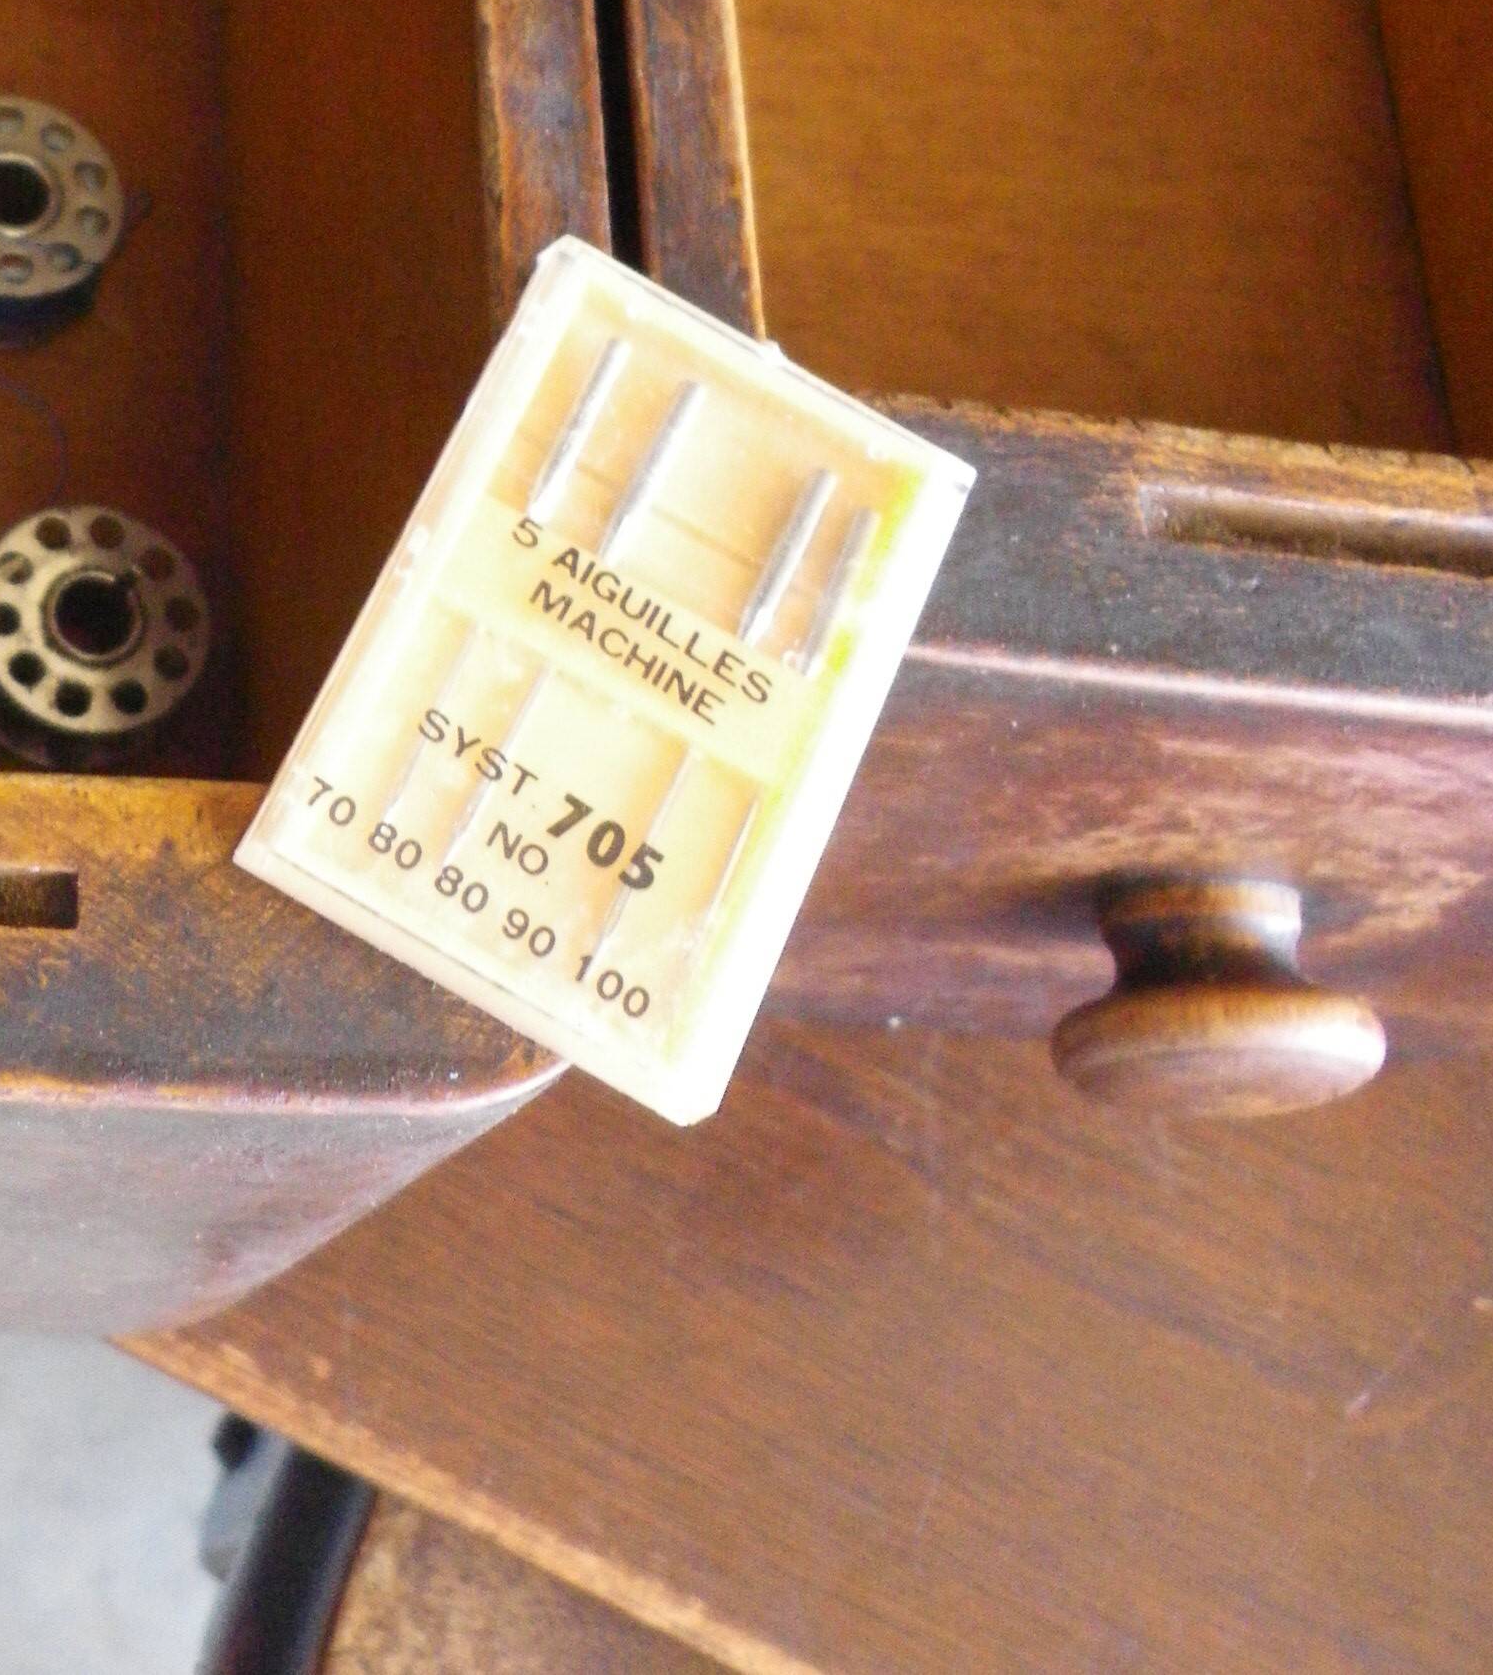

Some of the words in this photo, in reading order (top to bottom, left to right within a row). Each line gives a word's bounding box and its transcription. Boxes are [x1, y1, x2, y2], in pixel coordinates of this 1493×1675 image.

[511, 517, 543, 549] 5
[551, 546, 773, 705] AIGUILLES
[528, 578, 727, 726] MACHINE
[307, 775, 357, 827] 70
[367, 821, 422, 870] 80
[434, 865, 489, 913] 80
[501, 907, 556, 958] 90
[574, 954, 651, 1019] 100
[546, 792, 665, 890] 705
